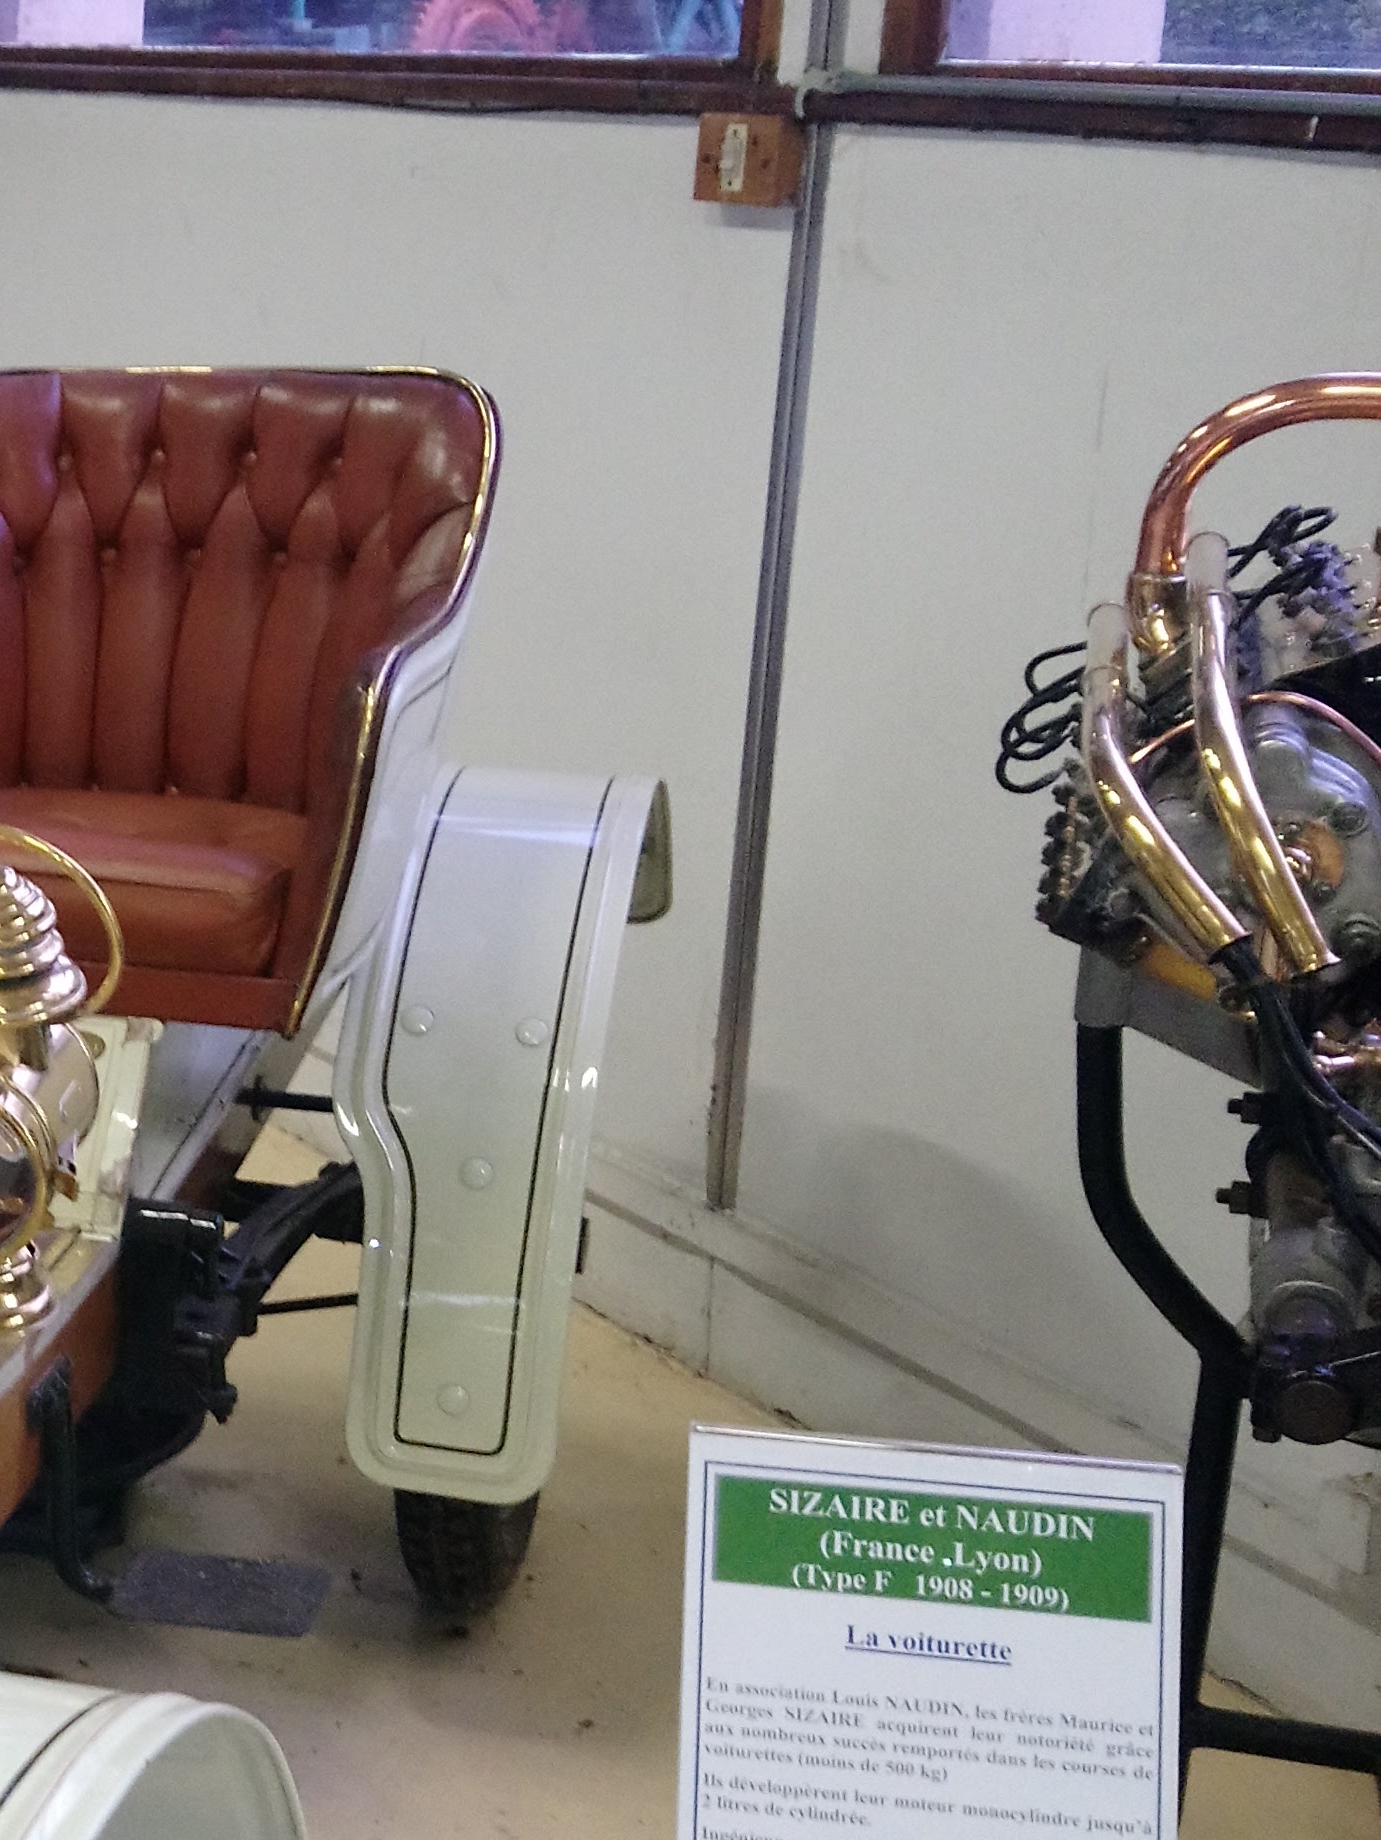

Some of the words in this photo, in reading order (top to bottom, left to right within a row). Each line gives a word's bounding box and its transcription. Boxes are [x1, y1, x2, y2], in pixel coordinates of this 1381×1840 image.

[769, 1487, 909, 1525] SIZAIRE
[919, 1503, 947, 1528] et
[955, 1504, 1094, 1541] NAUDIN
[819, 1529, 935, 1568] (France
[791, 1561, 866, 1594] (Type
[873, 1570, 892, 1592] F
[915, 1573, 974, 1601] 1908
[1000, 1581, 1069, 1614] 1909)
[845, 1624, 878, 1650] La
[888, 1628, 1012, 1663] voiturette
[705, 1698, 773, 1722] Georges
[784, 1706, 863, 1727] SIZAIRE
[876, 1715, 958, 1741] acquirent
[970, 1725, 1004, 1742] leur
[1105, 1738, 1154, 1761] grâce
[706, 1676, 728, 1692] En
[734, 1679, 825, 1702] association
[831, 1688, 879, 1707] Louis
[884, 1694, 969, 1718] NAUDIN,
[974, 1703, 998, 1719] les
[1059, 1711, 1132, 1733] Maurice
[1138, 1719, 1153, 1735] et
[704, 1723, 734, 1736] aux
[740, 1723, 827, 1745] nombreux
[832, 1733, 886, 1751] succès
[892, 1739, 979, 1765] remportés
[985, 1748, 1026, 1766] dans
[1032, 1753, 1055, 1769] les
[1060, 1760, 1126, 1777] courses
[1132, 1764, 1152, 1779] de
[704, 1741, 793, 1763] voiturettes
[797, 1751, 855, 1773] (moins
[859, 1757, 879, 1772] de
[885, 1760, 914, 1776] 500
[919, 1764, 948, 1783] kg)
[702, 1793, 710, 1808] 2
[717, 1795, 759, 1814] litres
[763, 1800, 783, 1816] de
[788, 1803, 871, 1829] cylindrée.
[703, 1772, 723, 1788] Ils
[853, 1788, 886, 1805] leur
[893, 1792, 955, 1813] moteur
[961, 1799, 1080, 1830] monocylindre
